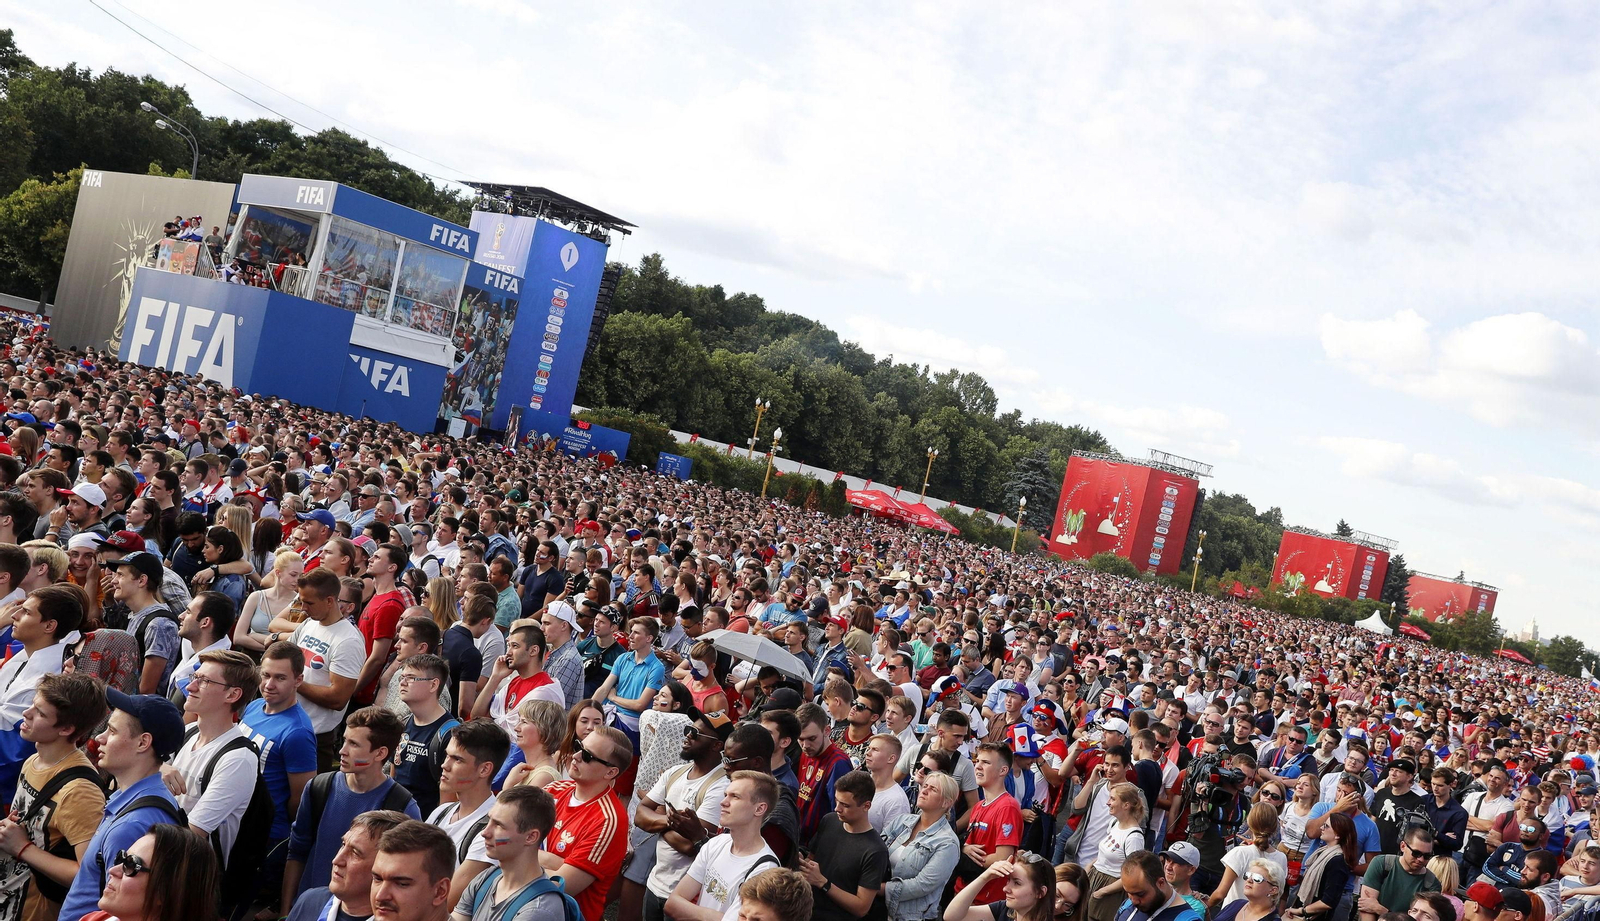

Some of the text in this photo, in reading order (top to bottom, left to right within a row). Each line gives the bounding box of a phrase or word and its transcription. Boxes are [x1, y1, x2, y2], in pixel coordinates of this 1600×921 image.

[82, 171, 102, 188] FIFA
[296, 185, 324, 206] FIFA
[429, 223, 470, 253] FIFA
[567, 248, 572, 262] 1
[499, 264, 516, 274] FEST
[484, 269, 519, 294] FIFA
[127, 296, 236, 390] FIFA
[348, 353, 410, 397] IFA
[300, 634, 330, 655] PEPSI
[406, 744, 428, 757] RUSSIA
